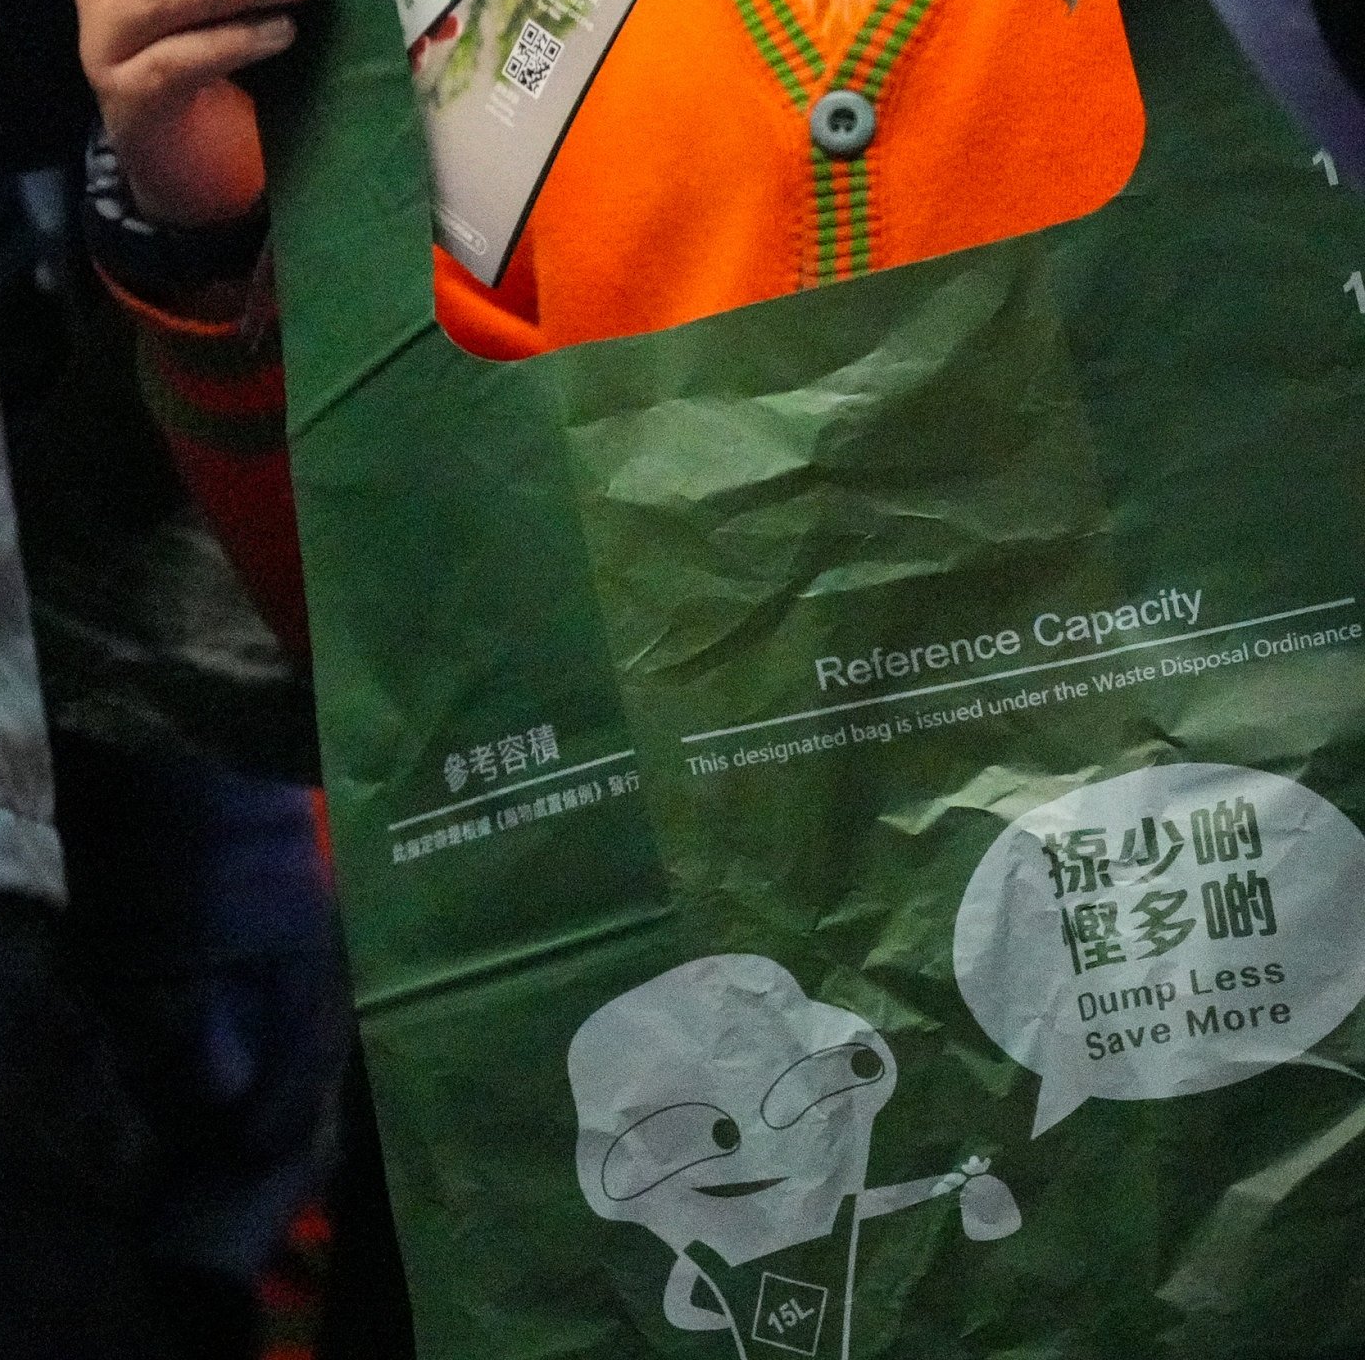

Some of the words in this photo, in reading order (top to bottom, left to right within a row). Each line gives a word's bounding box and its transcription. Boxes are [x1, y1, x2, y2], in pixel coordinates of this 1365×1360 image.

[815, 629, 1020, 690] Reference
[1033, 589, 1202, 646] Capacity
[686, 755, 729, 776] This
[733, 728, 847, 767] designated
[850, 721, 891, 742] bag
[896, 715, 913, 734] is
[918, 700, 982, 730] issued
[989, 689, 1048, 716] under
[1054, 681, 1089, 702] the
[1092, 664, 1156, 693] Waste
[1161, 644, 1249, 677] Disposal
[1254, 622, 1363, 658] Ordinance
[1061, 870, 1278, 975] 慳多啲
[1077, 979, 1176, 1022] Dump
[1190, 962, 1286, 996] Less
[1085, 1022, 1171, 1061] Save
[1186, 1002, 1291, 1038] More
[768, 1298, 815, 1334] 15L
